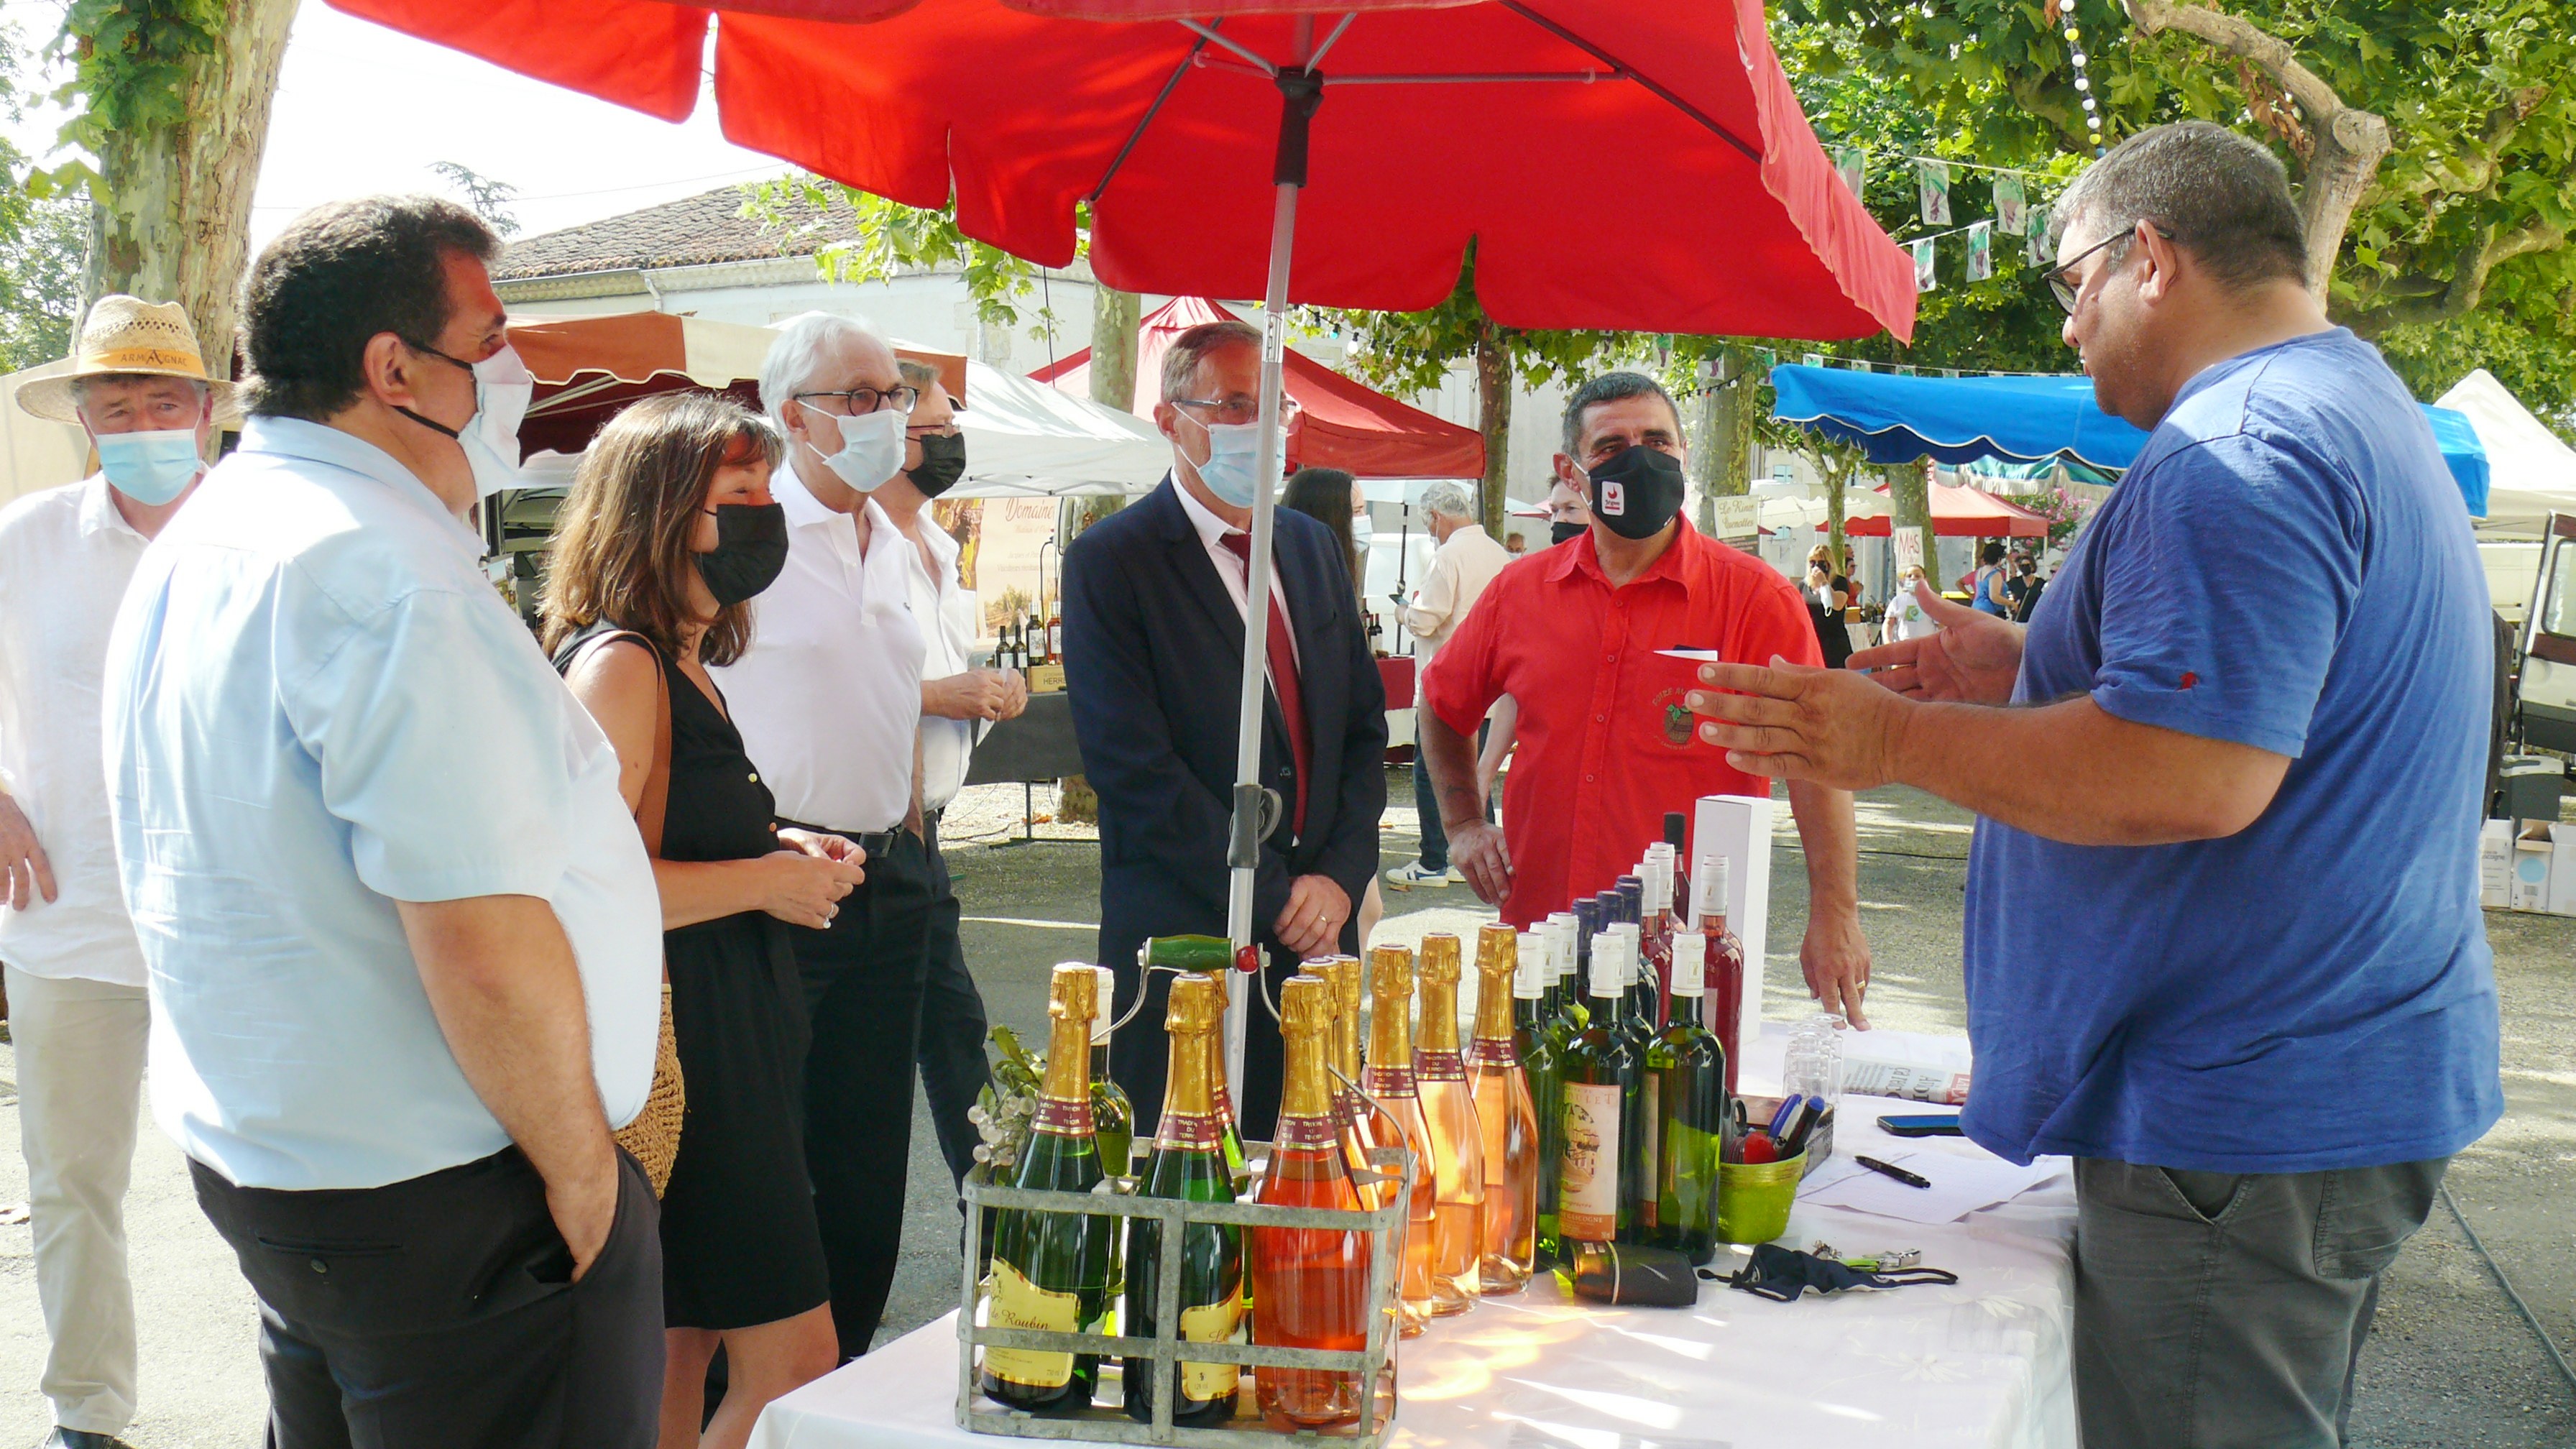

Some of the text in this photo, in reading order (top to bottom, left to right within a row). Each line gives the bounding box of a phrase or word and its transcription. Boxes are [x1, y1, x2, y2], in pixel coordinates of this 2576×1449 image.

[1005, 496, 1054, 522] Domaine
[1898, 532, 1920, 565] MAS
[1001, 1310, 1051, 1330] Roubin
